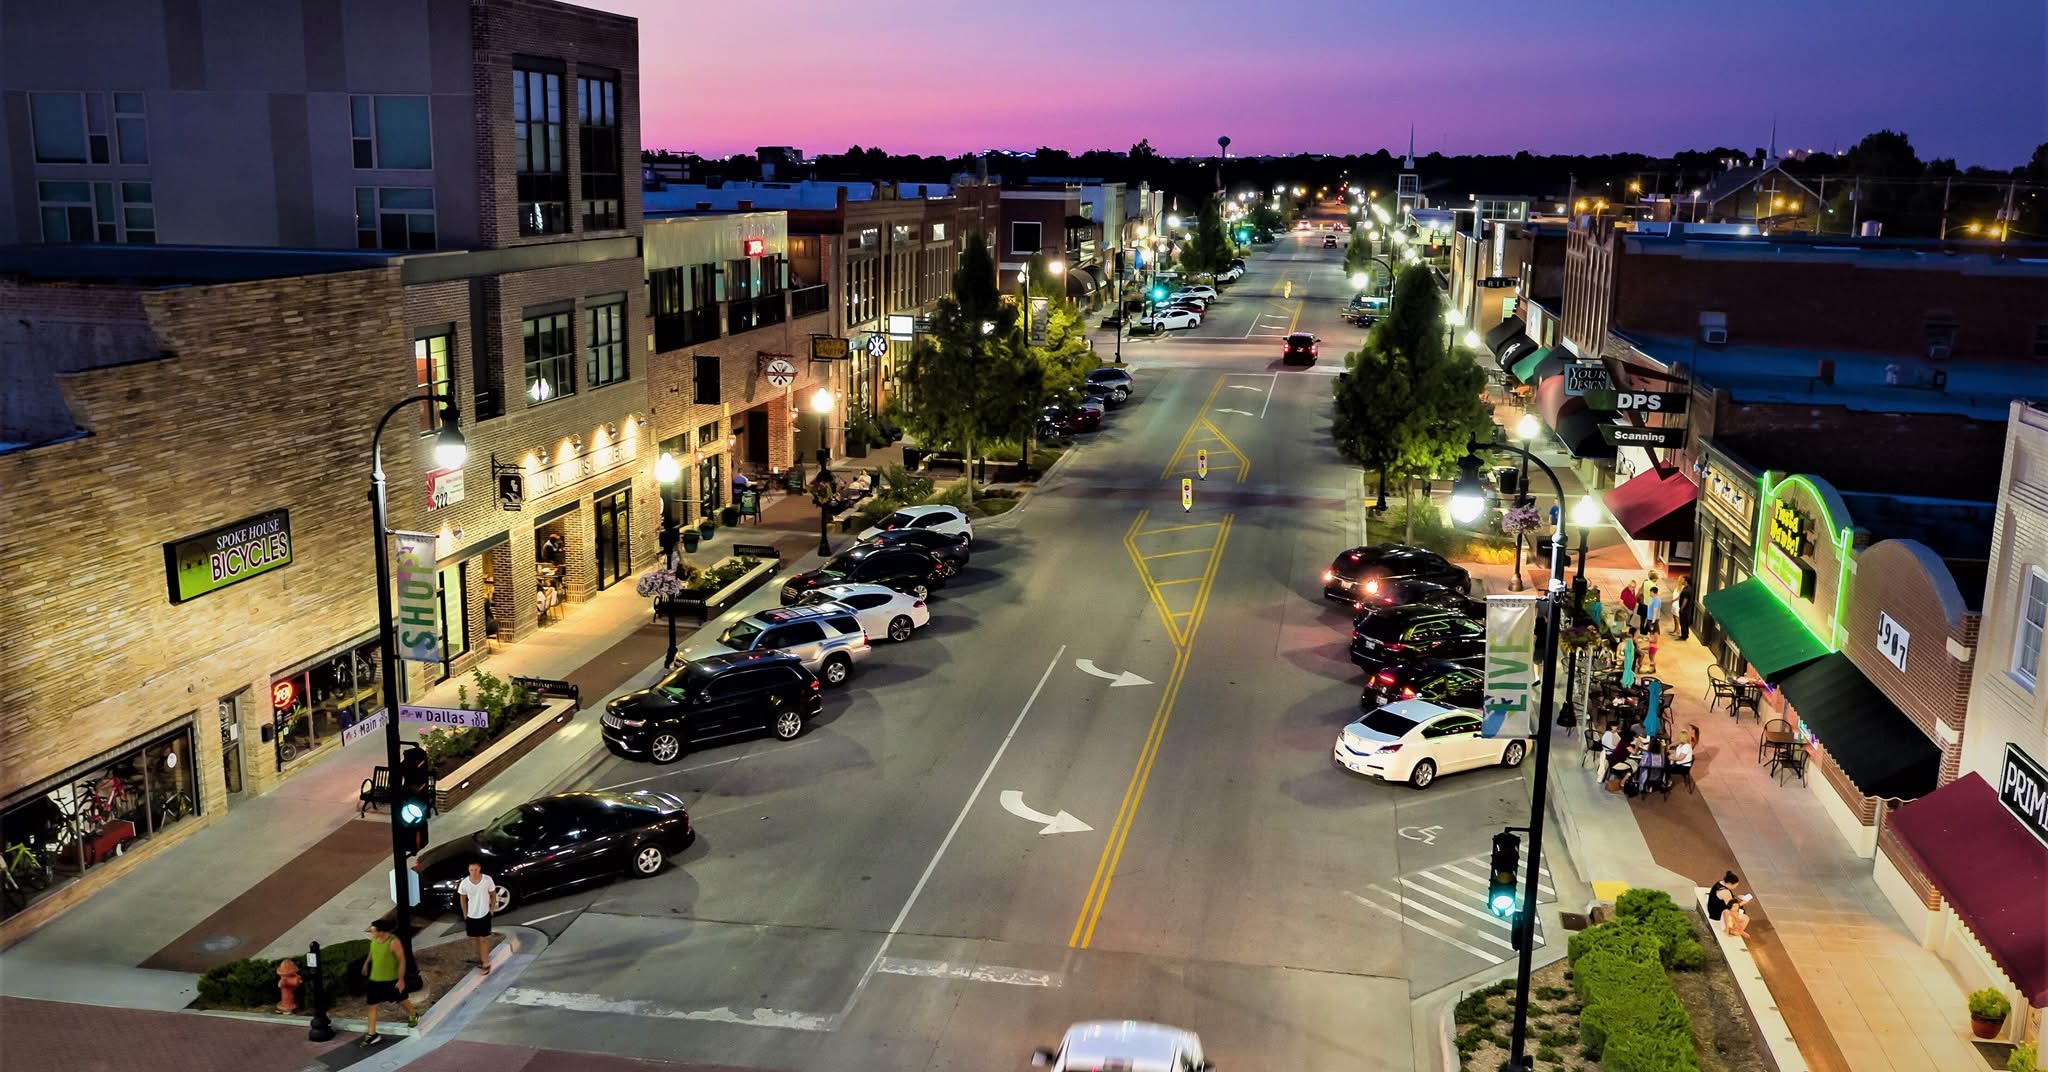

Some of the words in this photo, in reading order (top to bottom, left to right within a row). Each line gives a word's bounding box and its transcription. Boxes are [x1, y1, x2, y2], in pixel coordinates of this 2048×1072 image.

[1571, 367, 1606, 379] YOUR
[1569, 376, 1604, 390] DESIGN
[1617, 393, 1661, 410] DPS
[1614, 431, 1665, 443] Scanning
[435, 491, 448, 510] 222
[216, 528, 247, 550] SPOKE
[249, 519, 280, 540] HOUSE
[210, 531, 288, 583] BICYCLES
[399, 552, 436, 651] SHOP
[1878, 613, 1906, 669] 1907
[1486, 634, 1529, 712] LIVE
[415, 711, 423, 719] W
[426, 710, 465, 724] Dallas
[474, 711, 482, 720] St
[471, 718, 486, 728] 100
[359, 719, 377, 736] Main
